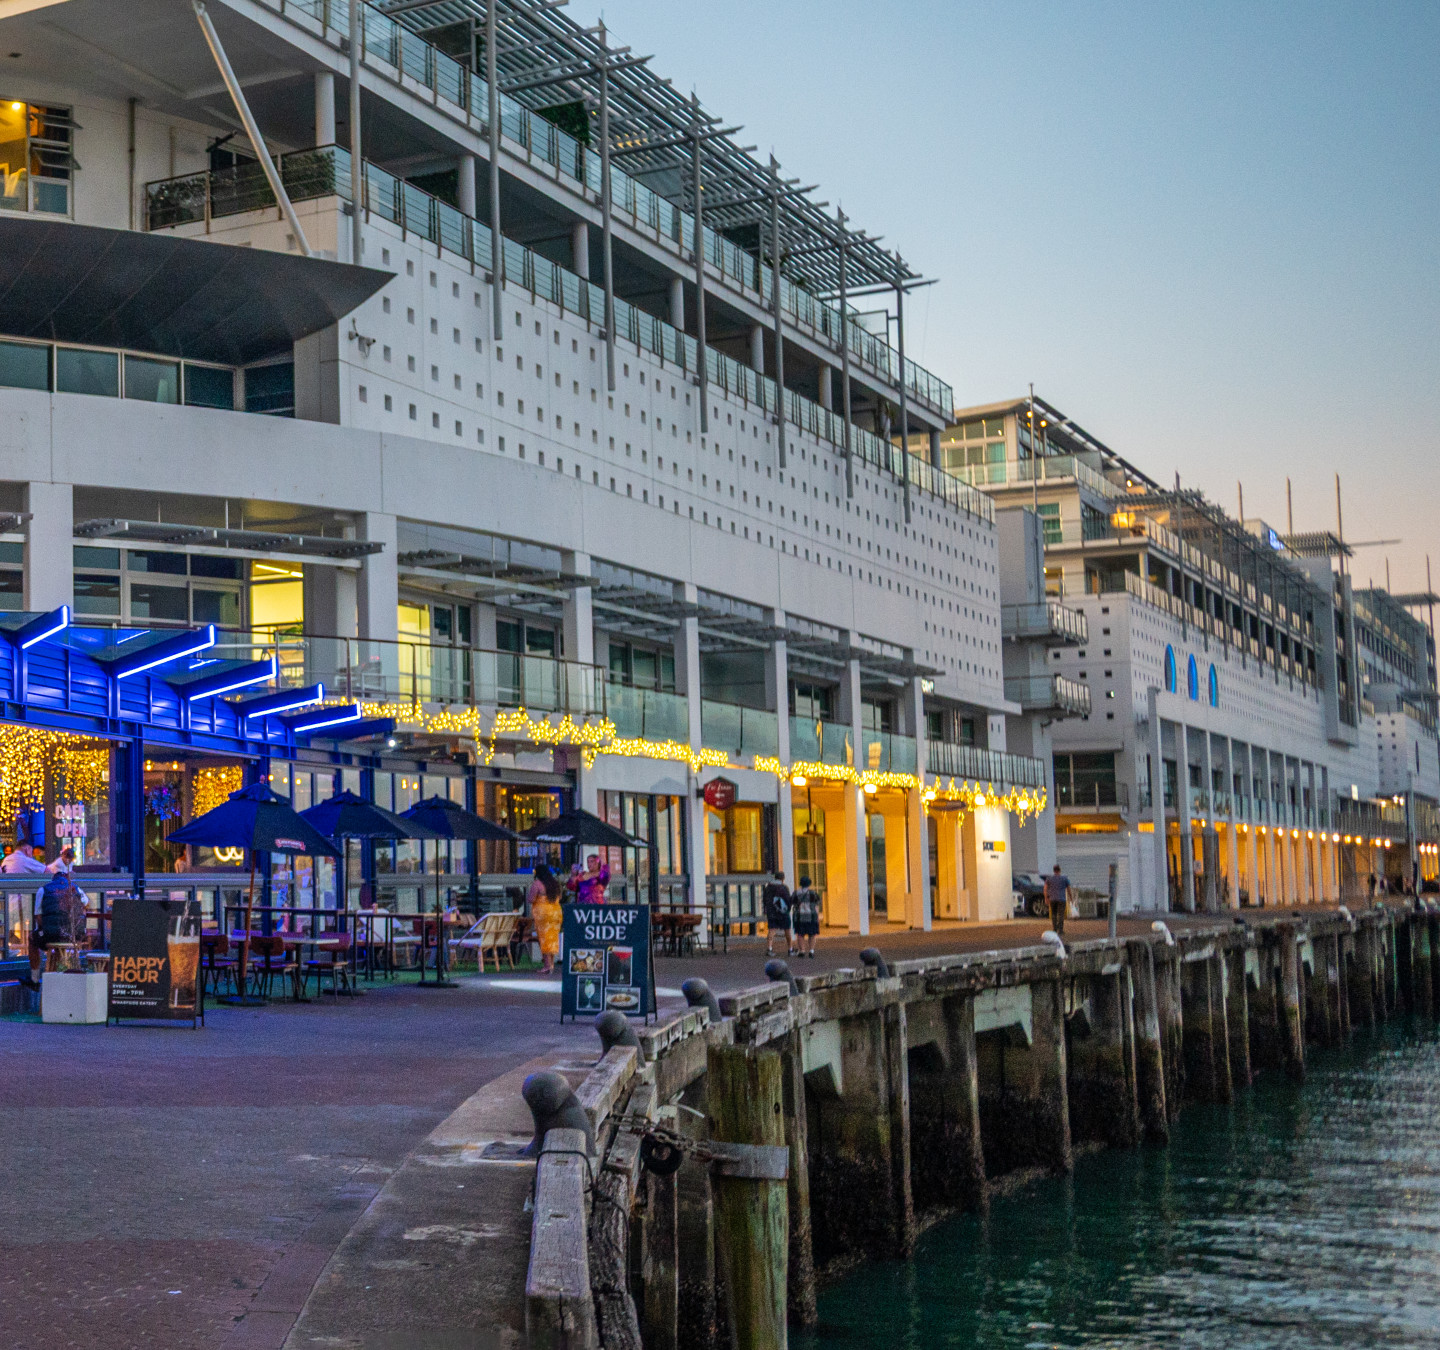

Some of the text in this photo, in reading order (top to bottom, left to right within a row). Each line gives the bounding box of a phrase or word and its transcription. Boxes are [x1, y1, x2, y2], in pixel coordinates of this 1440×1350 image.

[55, 822, 88, 838] OPEN
[573, 909, 639, 924] WHARF
[584, 925, 627, 940] SIDE
[113, 956, 166, 970] HAPPY
[113, 969, 159, 983] HOUR
